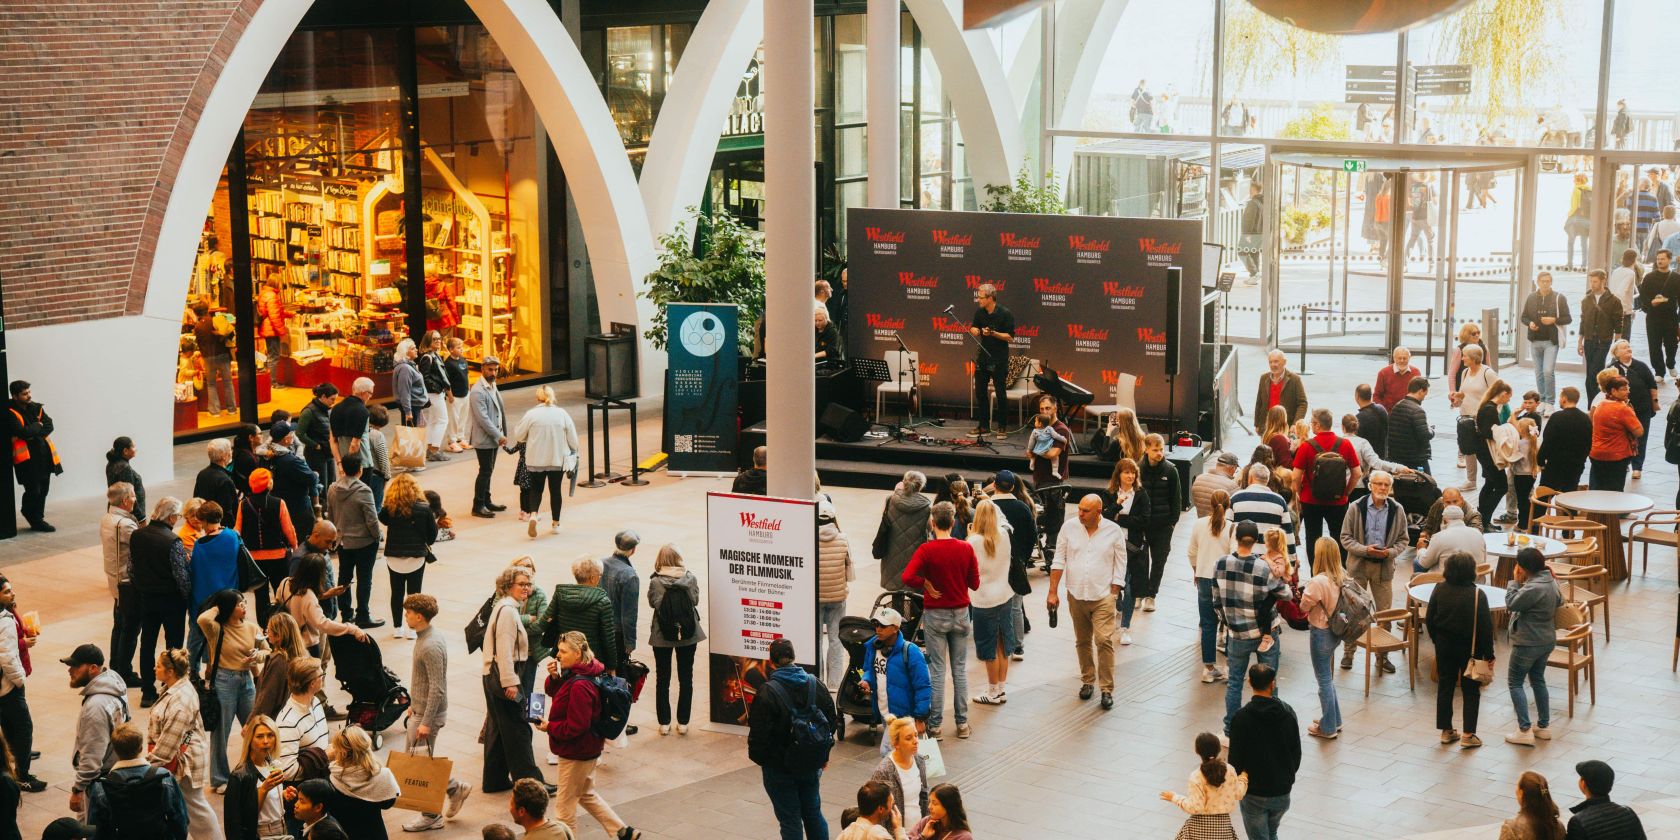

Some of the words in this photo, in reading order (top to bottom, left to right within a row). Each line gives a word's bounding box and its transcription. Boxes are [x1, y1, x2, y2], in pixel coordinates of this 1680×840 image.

[865, 227, 905, 243] Westfield
[932, 229, 973, 246] Westfield
[1000, 232, 1041, 249] Westfield
[1068, 235, 1110, 251] Westfield
[1008, 248, 1032, 256] HAMBURG
[1139, 238, 1182, 254] Westfield
[1147, 254, 1172, 262] HAMBURG
[898, 271, 939, 288] Westfield
[1033, 278, 1075, 295] Westfield
[906, 287, 930, 295] HAMBURG
[1103, 281, 1145, 297] Westfield
[1041, 294, 1066, 302] HAMBURG
[1111, 297, 1136, 305] HAMBURG
[866, 313, 905, 329] Westfield
[683, 327, 723, 352] LOOP
[1067, 323, 1109, 341] Westfield
[739, 512, 782, 531] Westfield
[720, 549, 760, 564] MAGISCHE
[763, 553, 804, 568] MOMENTE
[729, 563, 744, 575] DER
[747, 565, 794, 580] FILMMUSIK.
[405, 778, 429, 788] FEATURE
